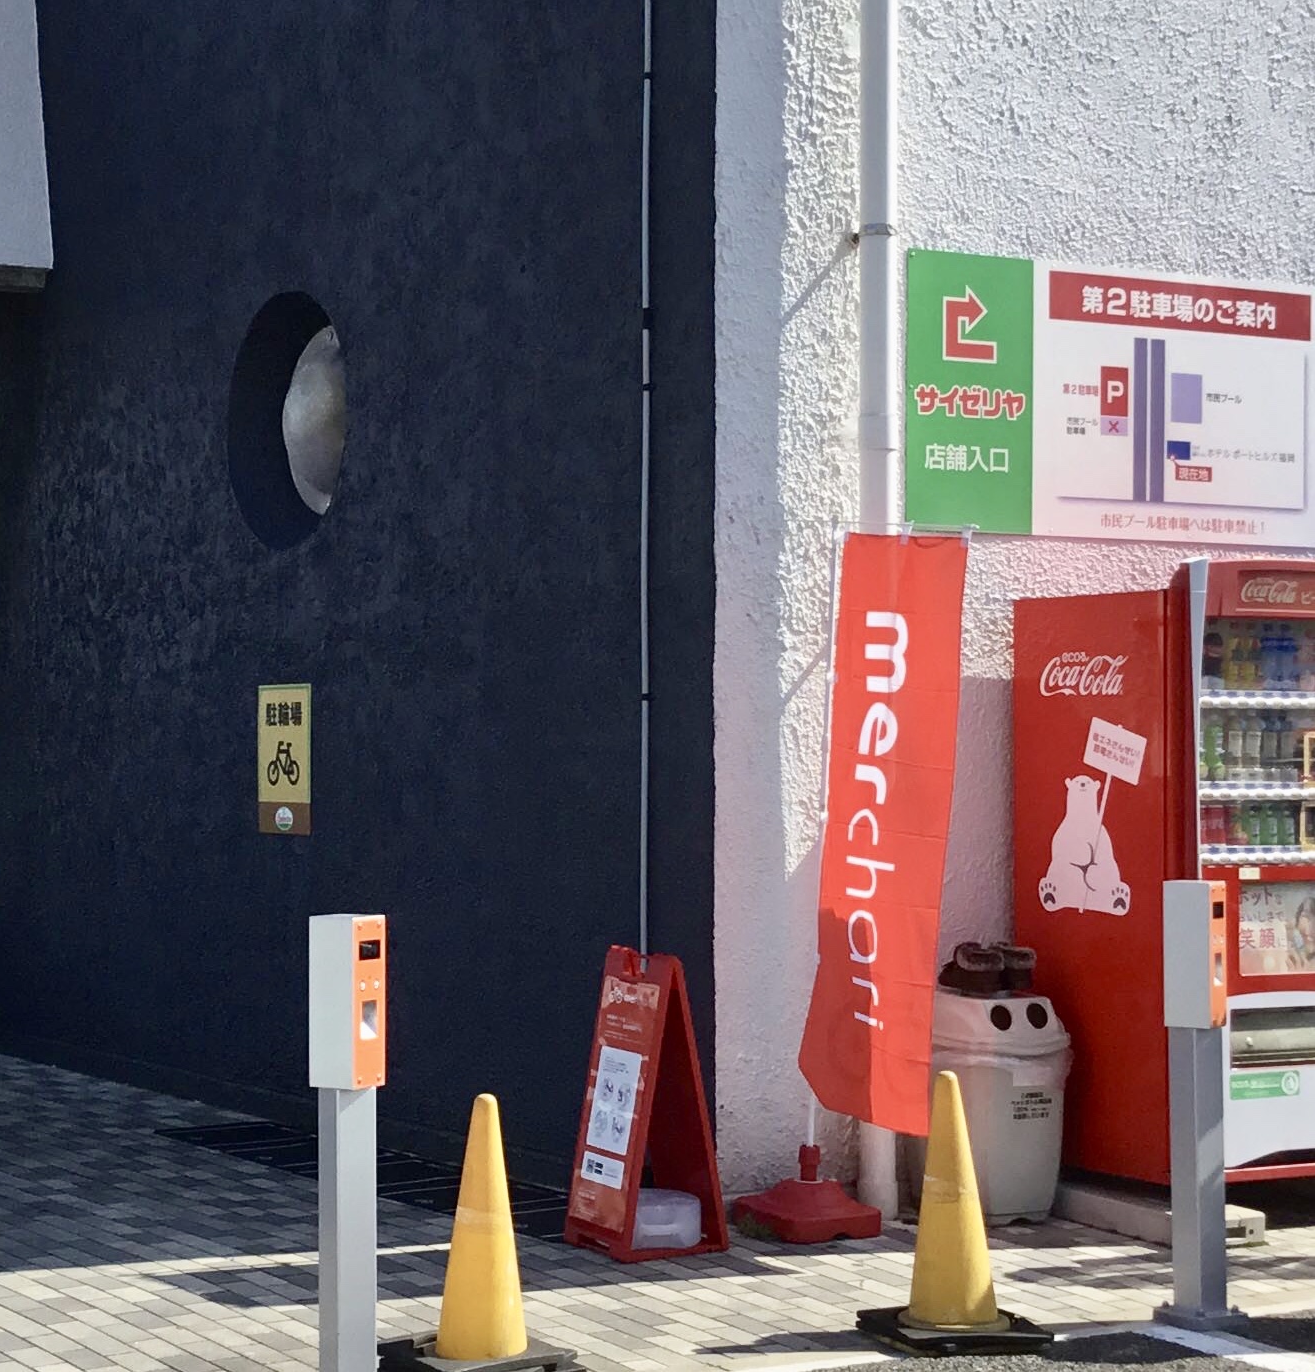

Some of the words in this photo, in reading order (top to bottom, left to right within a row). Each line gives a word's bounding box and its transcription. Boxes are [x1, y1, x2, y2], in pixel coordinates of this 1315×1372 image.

[914, 384, 1026, 421] サイゼリヤ
[1107, 380, 1125, 404] P
[925, 443, 1009, 473] 店舗入口
[1040, 655, 1129, 696] Coca-Cola
[266, 702, 302, 726] 駐輪場
[846, 610, 910, 1032] merchari
